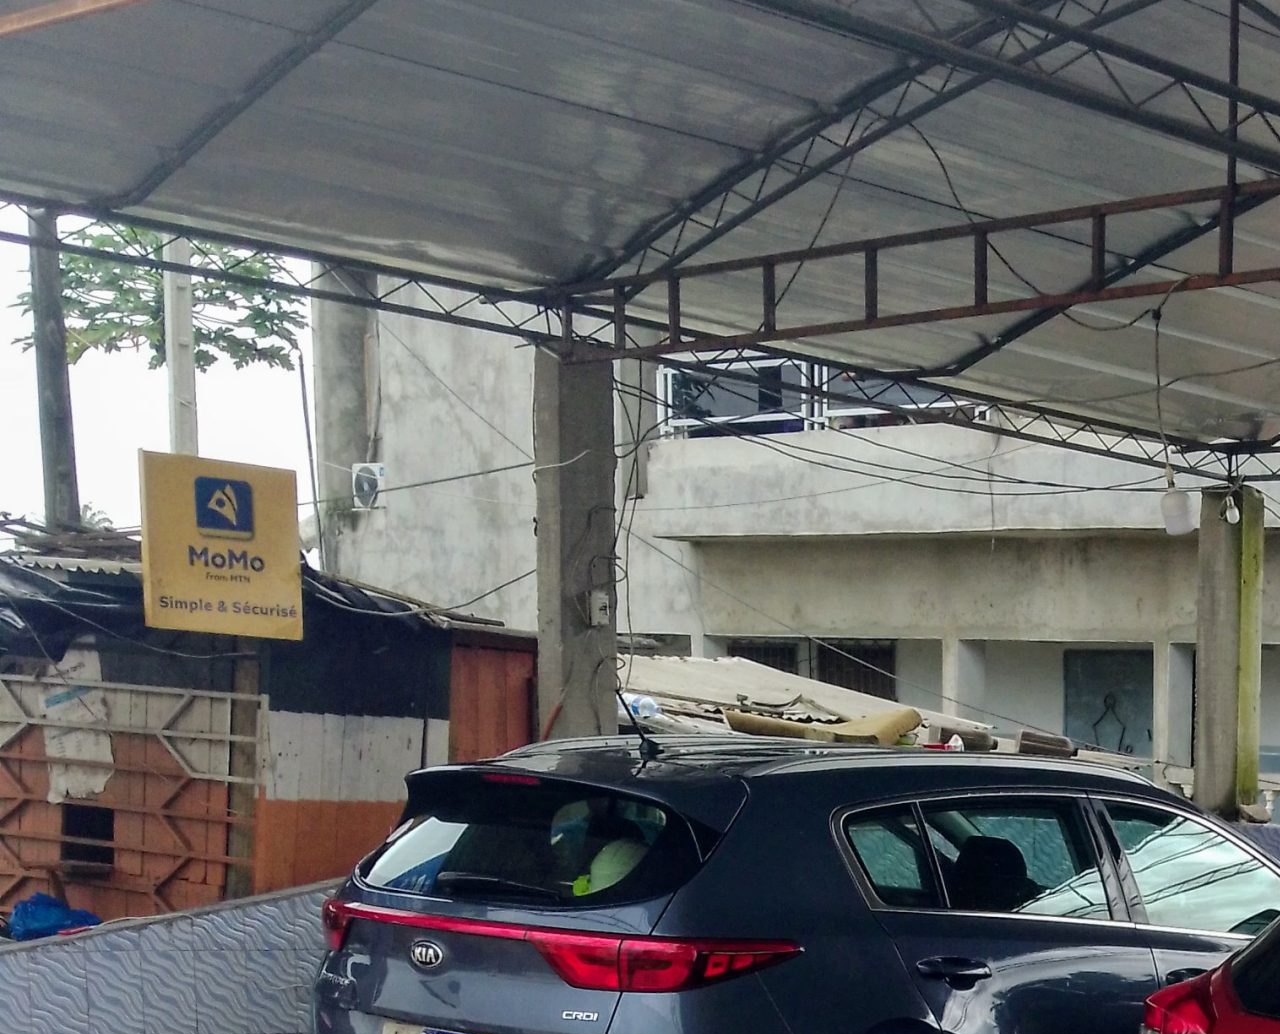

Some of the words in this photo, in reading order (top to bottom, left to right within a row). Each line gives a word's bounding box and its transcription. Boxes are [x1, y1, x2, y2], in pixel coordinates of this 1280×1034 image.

[188, 545, 264, 572] MoMo
[206, 572, 228, 582] from
[230, 574, 251, 583] MTN
[159, 596, 213, 613] Simple
[217, 600, 228, 613] &
[232, 601, 298, 618] Sécurisé
[414, 946, 436, 963] KIA
[562, 1011, 599, 1021] CRDI
